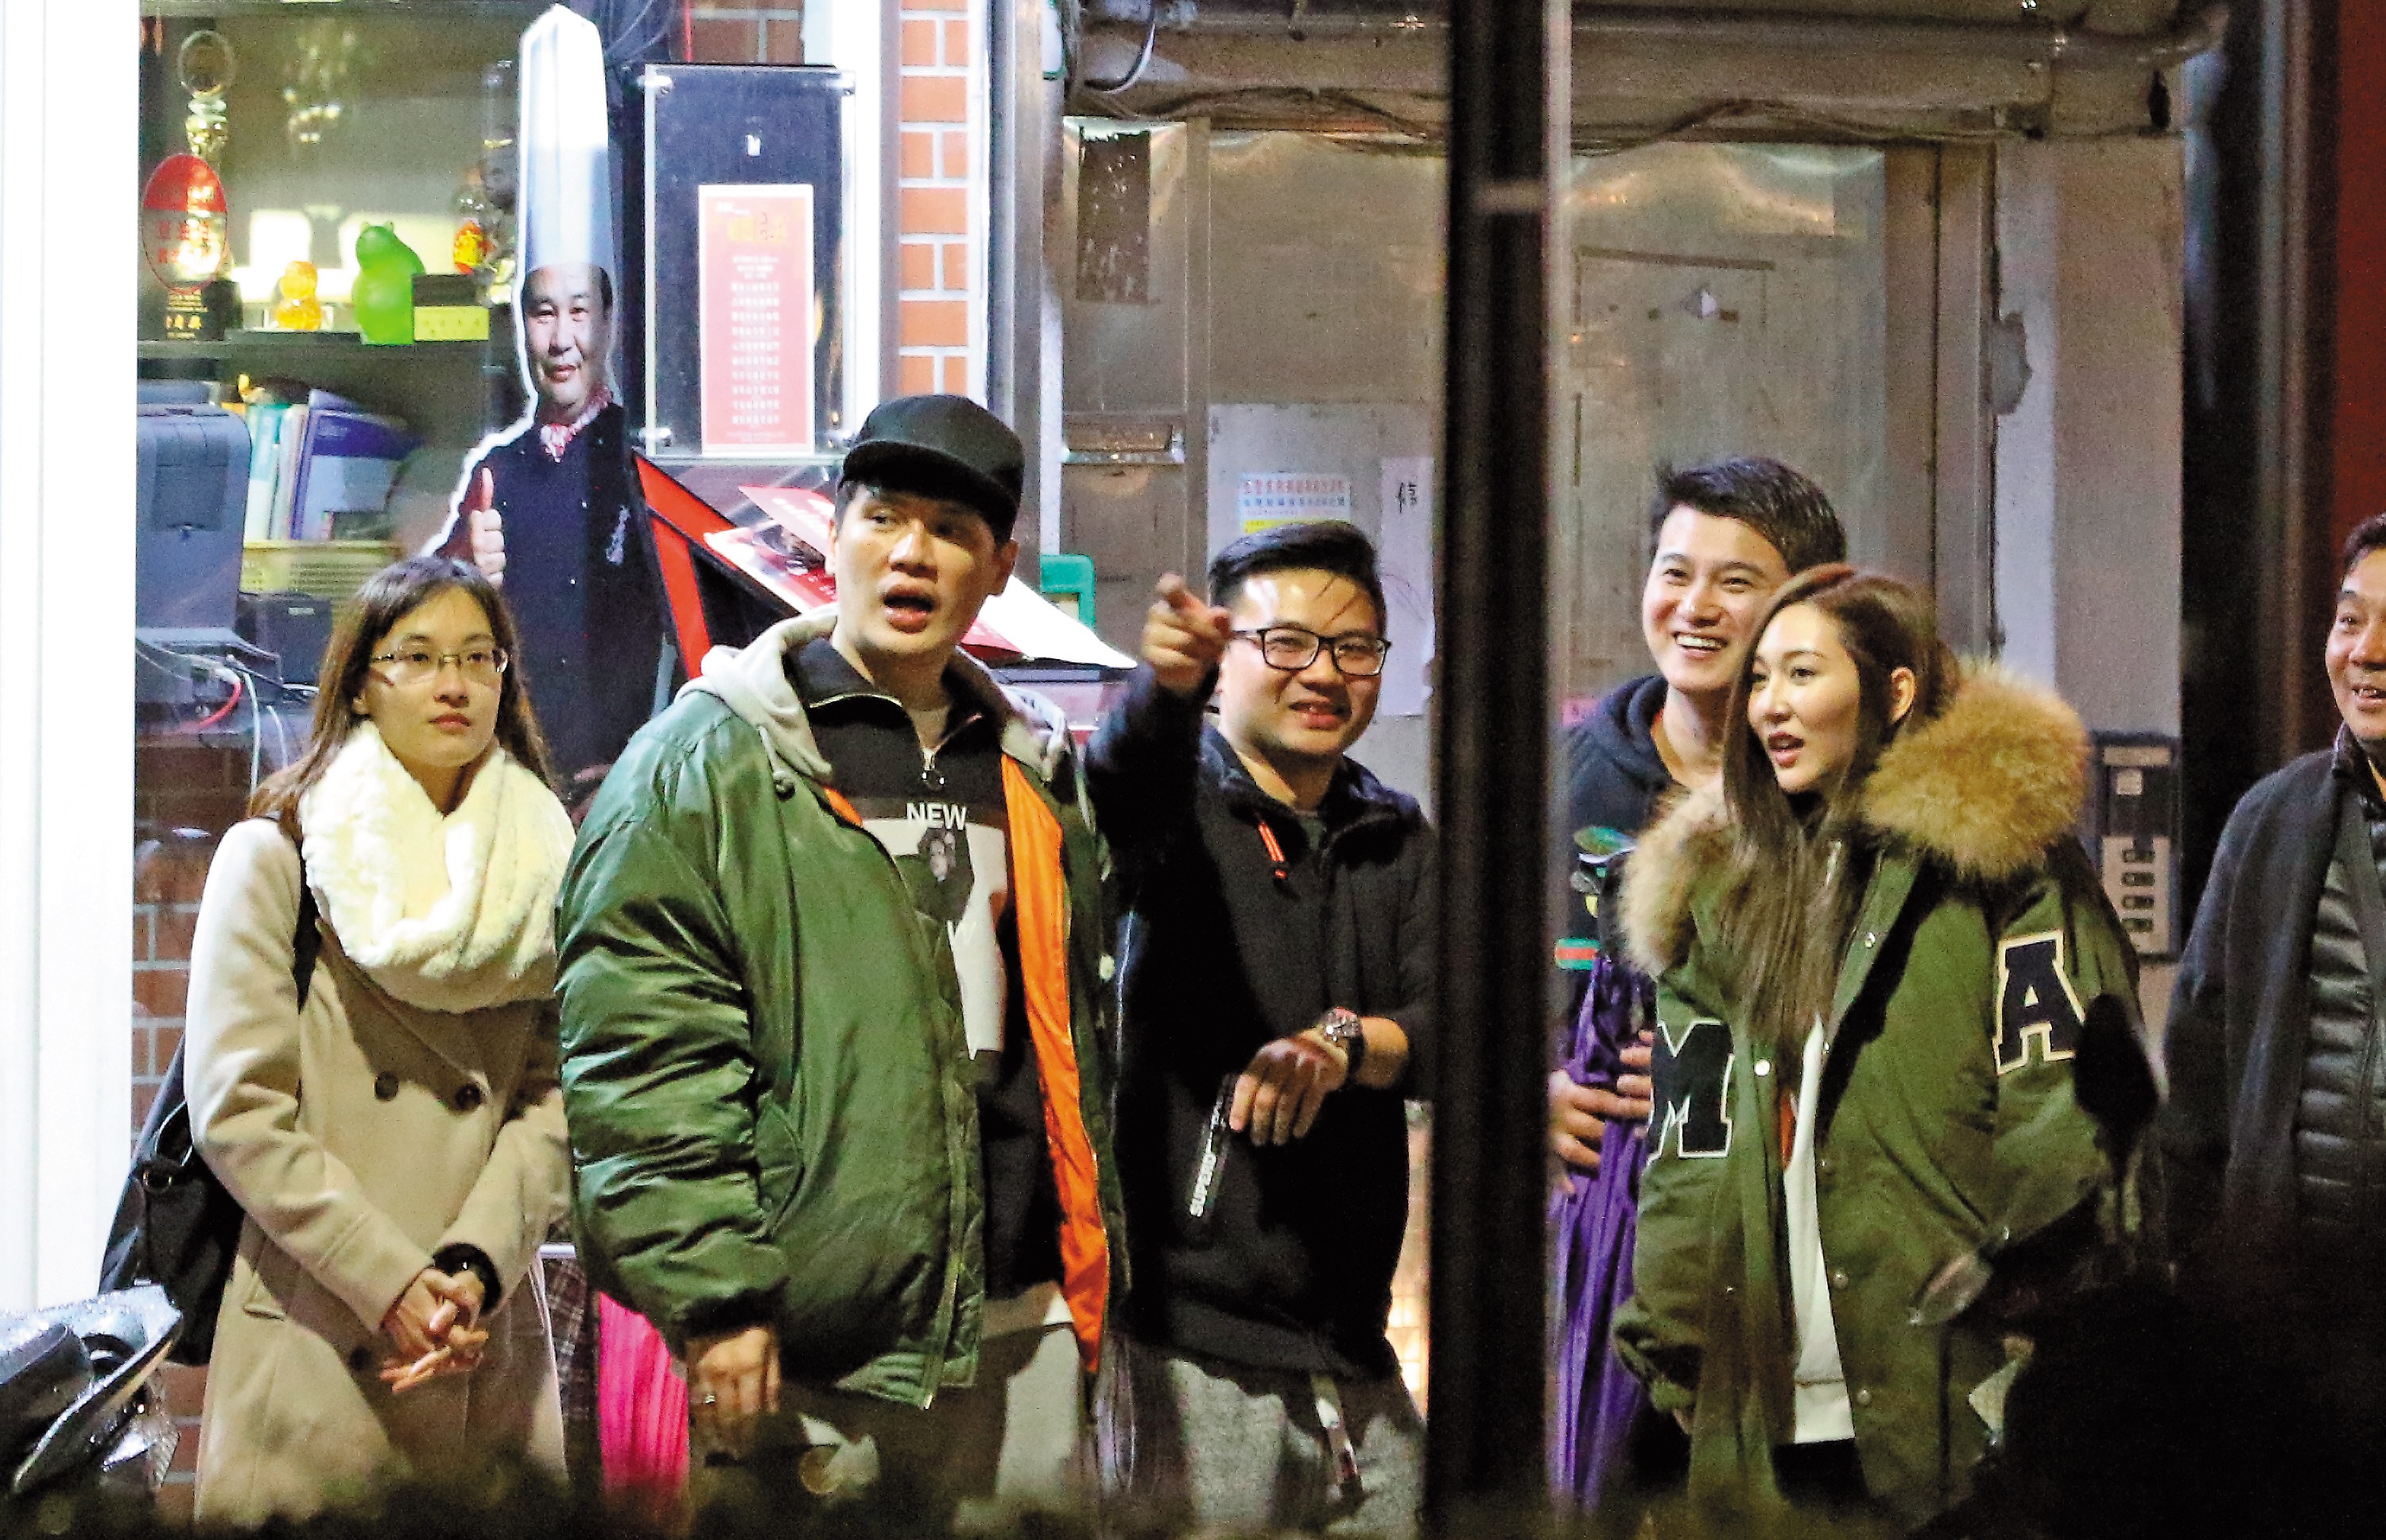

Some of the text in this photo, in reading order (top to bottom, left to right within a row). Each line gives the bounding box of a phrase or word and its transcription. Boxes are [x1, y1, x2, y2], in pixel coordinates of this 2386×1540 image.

[906, 802, 967, 831] NEW
[1992, 929, 2085, 1076] A
[1647, 1019, 1735, 1158] M
